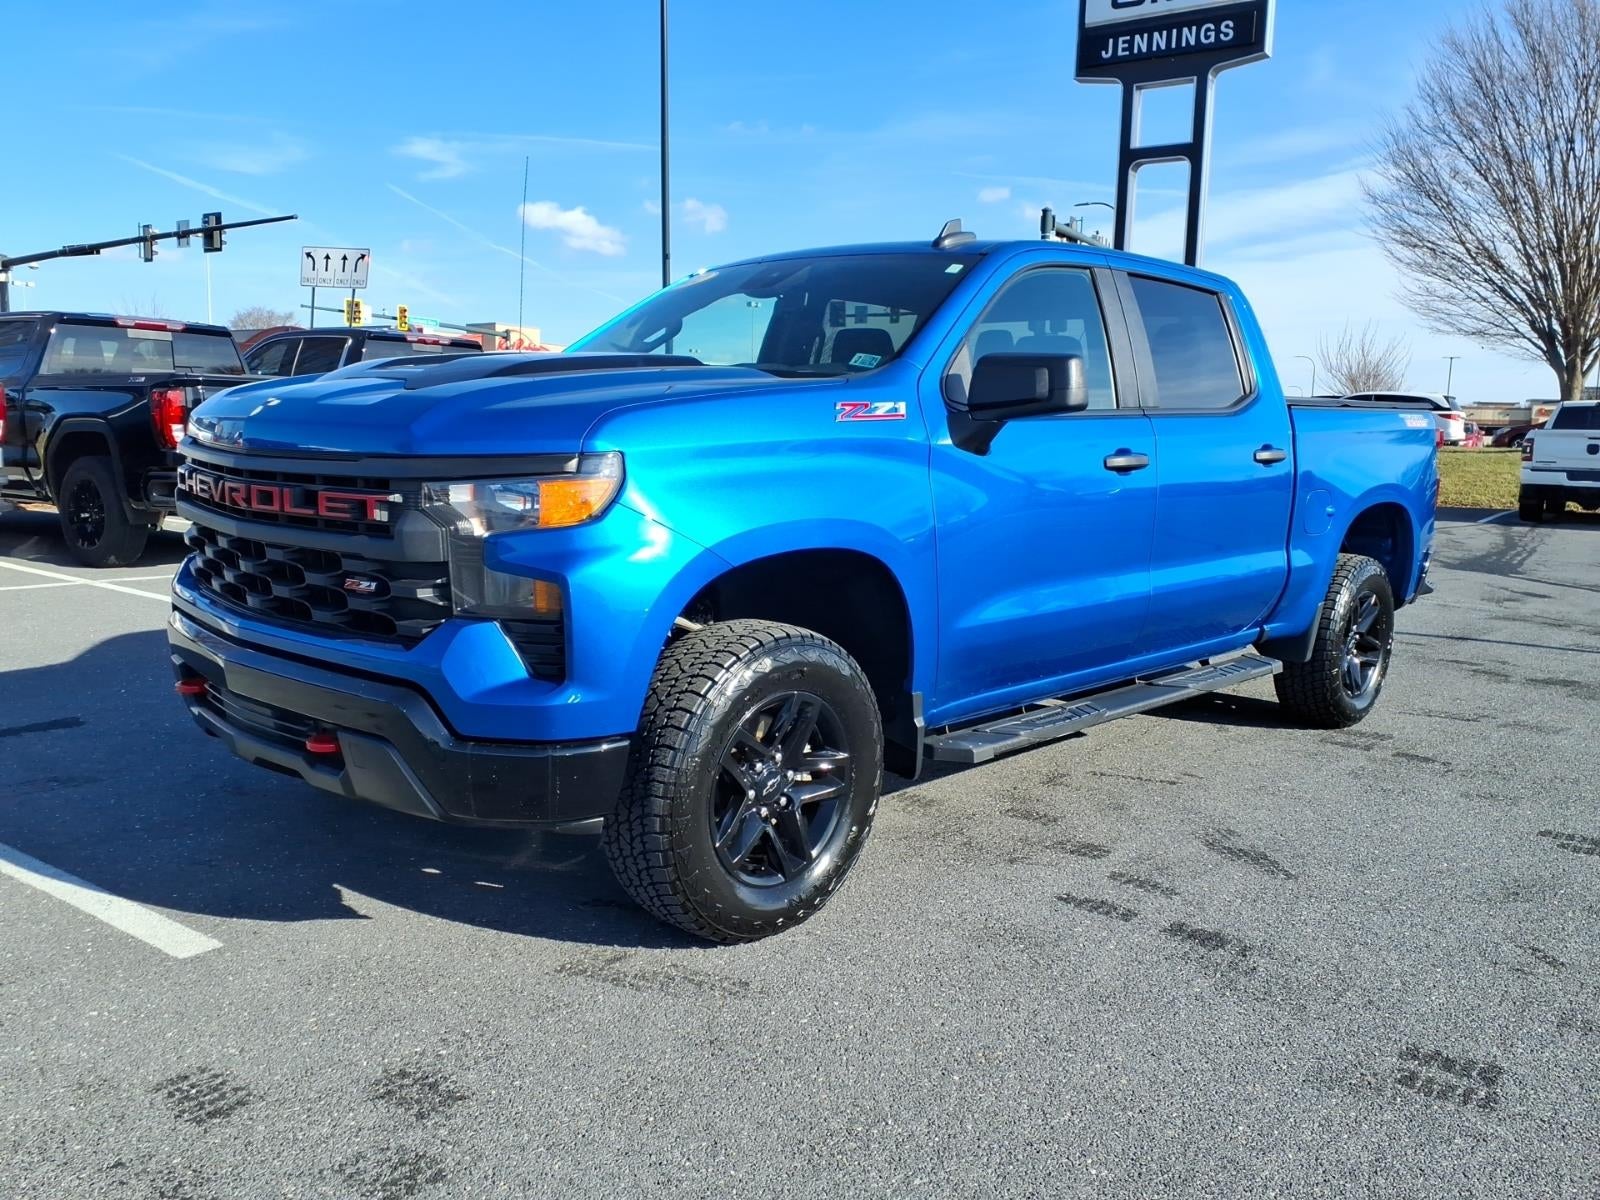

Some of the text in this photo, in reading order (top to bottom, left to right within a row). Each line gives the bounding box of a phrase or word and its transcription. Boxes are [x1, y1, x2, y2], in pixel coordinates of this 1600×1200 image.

[1101, 20, 1234, 58] JENNINGS
[302, 276, 316, 284] ONLY
[318, 277, 332, 285] ONLY
[335, 278, 349, 286] ONLY
[835, 401, 906, 422] Z71
[177, 466, 403, 522] CHEVROLET
